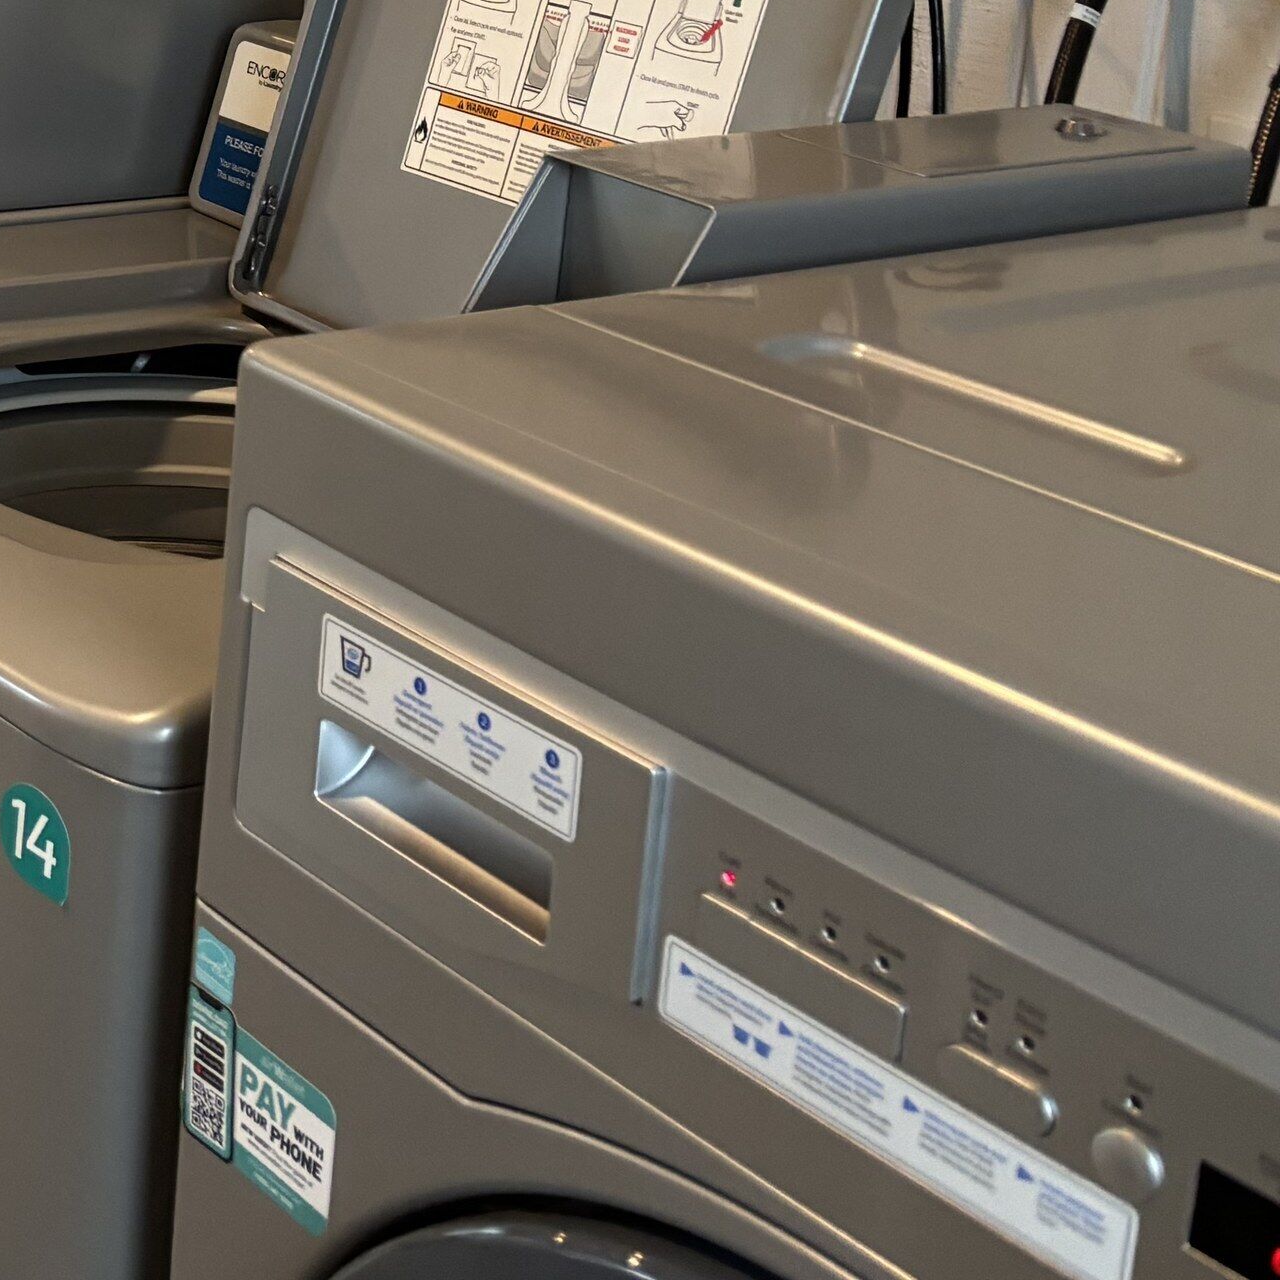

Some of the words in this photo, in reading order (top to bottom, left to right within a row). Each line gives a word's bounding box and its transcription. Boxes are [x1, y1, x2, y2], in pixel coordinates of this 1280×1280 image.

[246, 60, 287, 87] ENCOR
[465, 100, 499, 119] WARNING
[224, 134, 254, 154] PLEASE
[253, 145, 265, 158] FO
[540, 125, 602, 148] AVERTISSEMENT
[11, 798, 57, 880] 14
[239, 1063, 297, 1132] PAY
[292, 1124, 325, 1162] WITH
[238, 1095, 269, 1133] YOUR
[269, 1123, 324, 1183] PHONE
